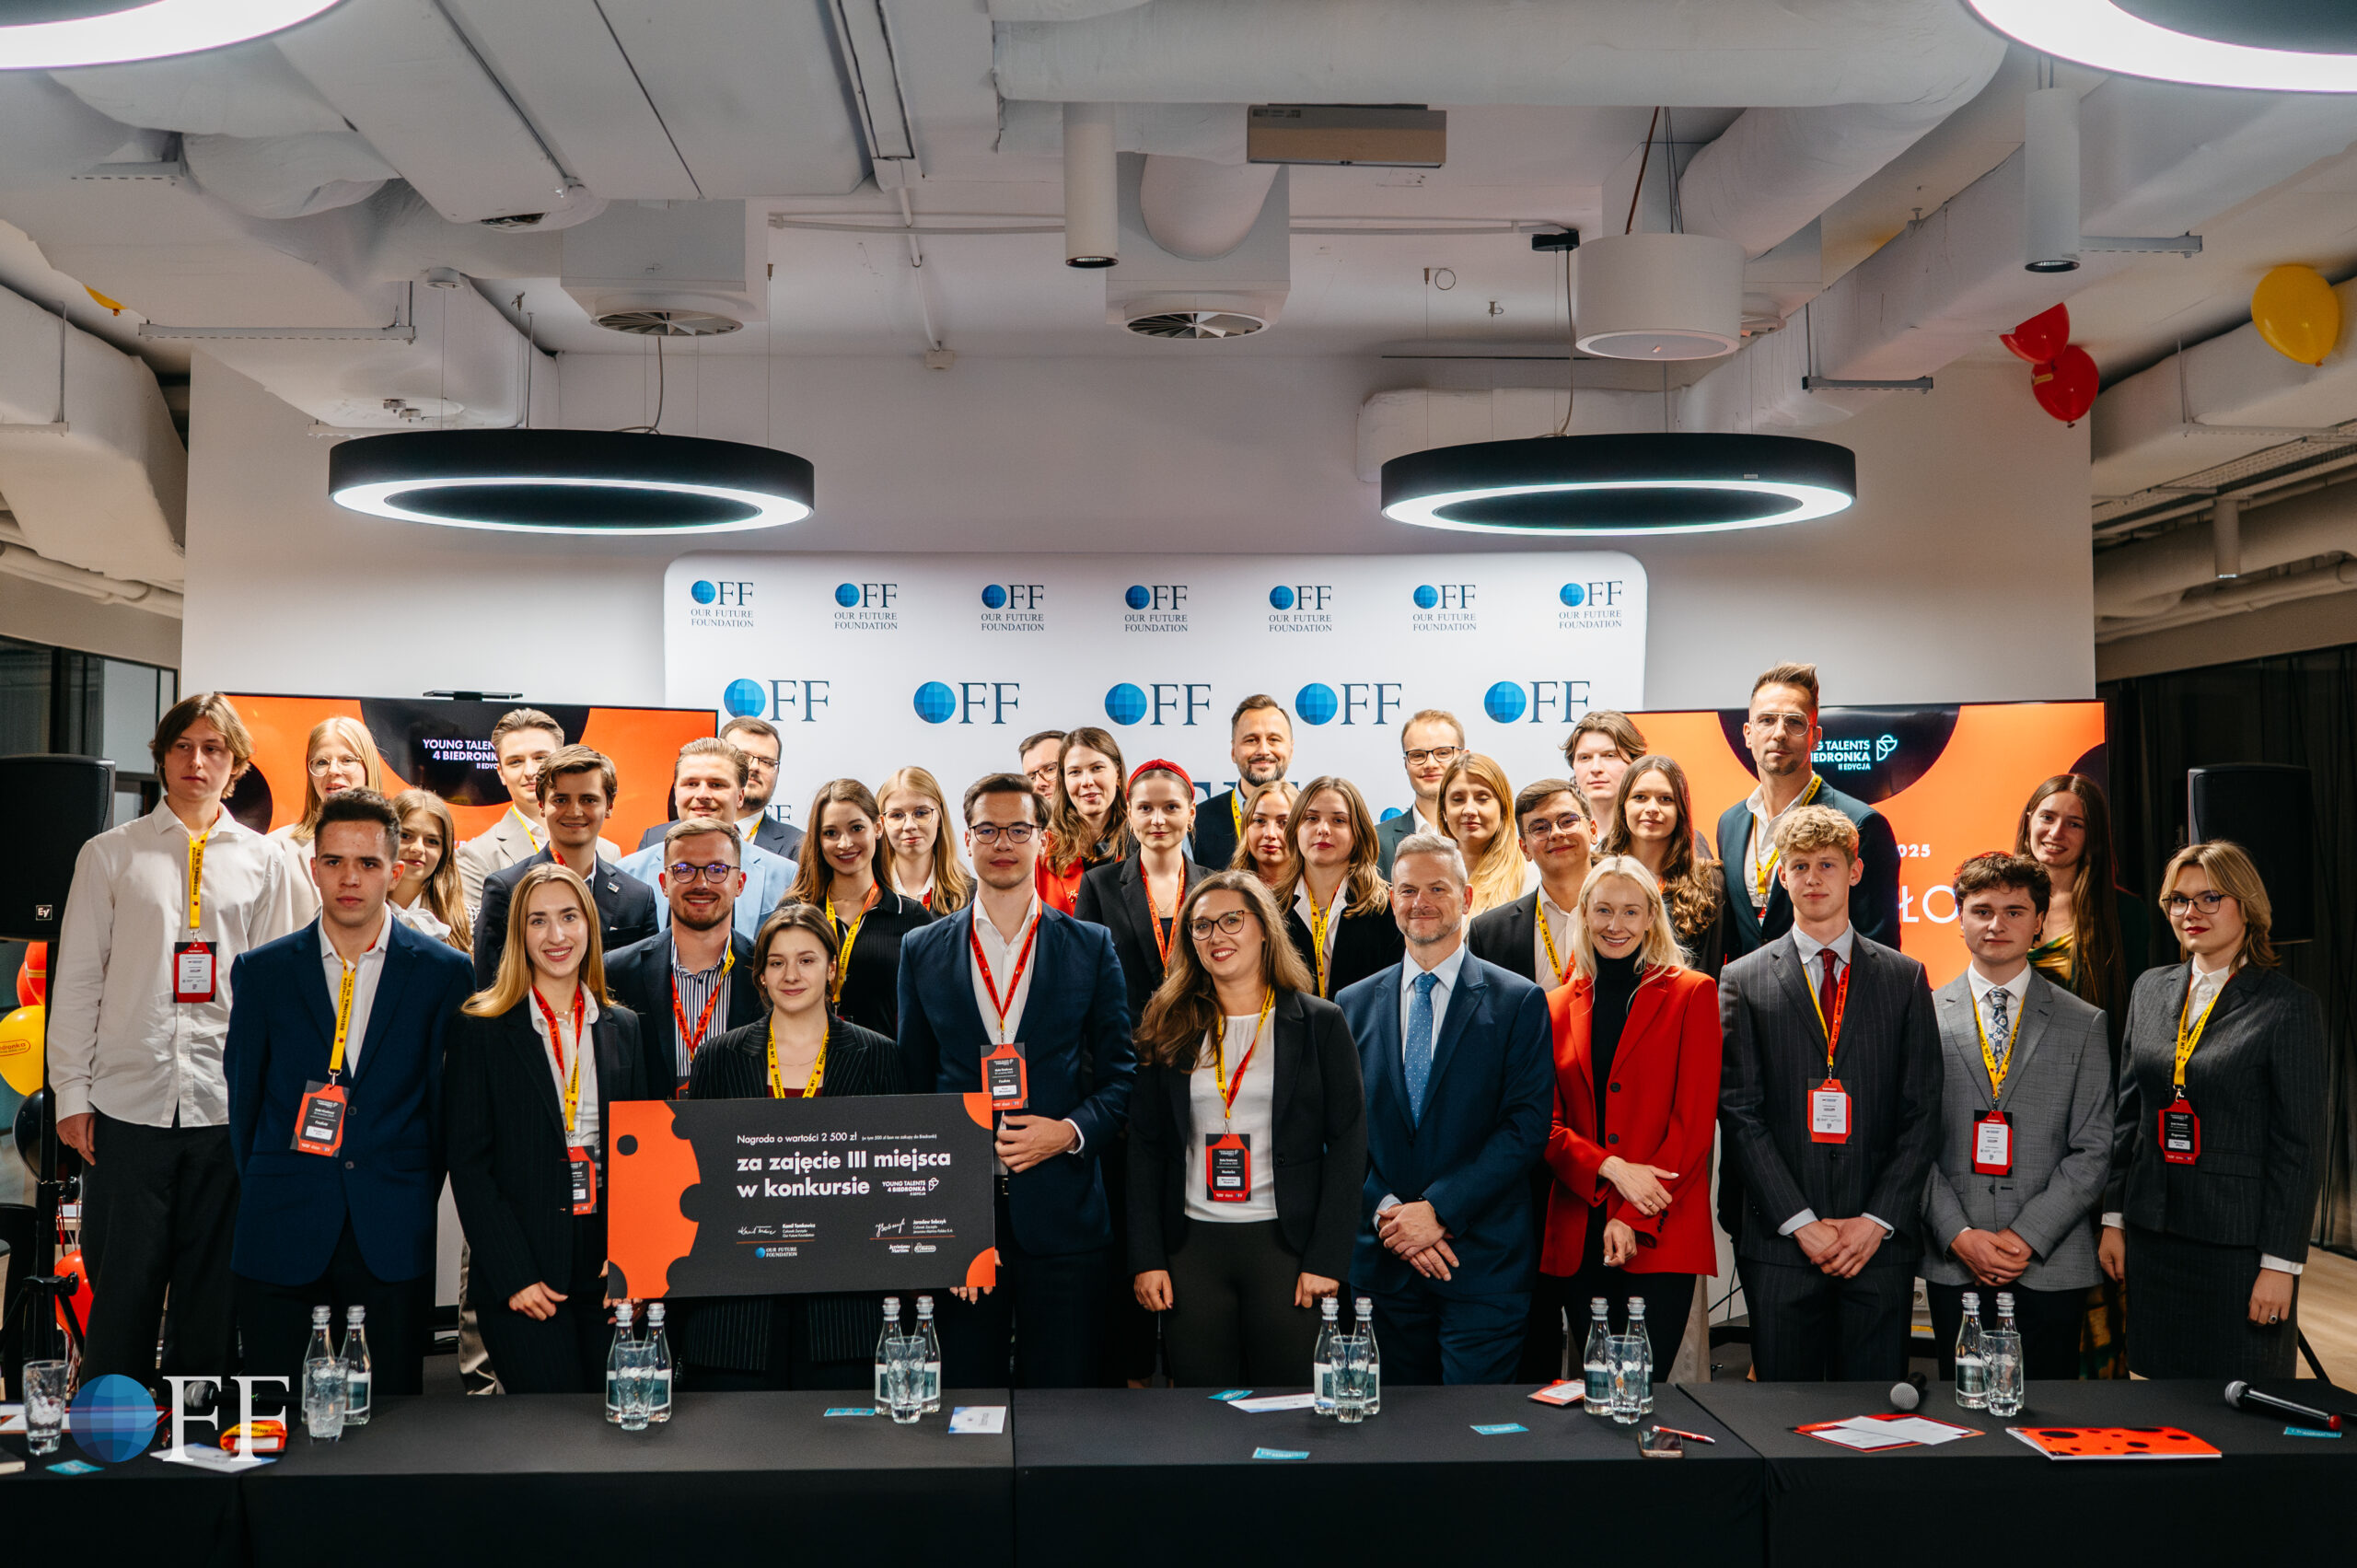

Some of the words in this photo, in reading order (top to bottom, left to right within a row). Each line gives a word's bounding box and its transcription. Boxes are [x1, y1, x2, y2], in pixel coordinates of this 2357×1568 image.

[691, 609, 712, 618] OUR
[715, 609, 754, 618] FUTURE
[834, 611, 855, 621] OUR
[859, 611, 898, 621] FUTURE
[981, 613, 1002, 622] OUR
[1005, 613, 1044, 622] FUTURE
[1124, 613, 1145, 622] OUR
[1149, 613, 1188, 622] FUTURE
[1269, 614, 1290, 623] OUR
[1294, 614, 1332, 623] FUTURE
[1412, 613, 1434, 622] OUR
[1437, 613, 1476, 622] FUTURE
[1559, 610, 1580, 619] OUR
[1584, 610, 1622, 619] FUTURE
[691, 619, 754, 628] FOUNDATION
[834, 621, 898, 631] FOUNDATION
[981, 622, 1044, 632] FOUNDATION
[1124, 623, 1188, 633] FOUNDATION
[1269, 623, 1332, 633] FOUNDATION
[1412, 622, 1476, 632] FOUNDATION
[1559, 620, 1622, 629] FOUNDATION
[423, 738, 464, 750] YOUNG
[465, 740, 496, 750] TALEN
[1825, 739, 1871, 751] TALENTS
[432, 750, 441, 761] 4
[442, 750, 499, 761] BIEDRONK
[1810, 751, 1871, 762] IEDRONKA
[1843, 762, 1871, 771] EDYCJA
[1898, 843, 1931, 857] 025
[774, 1074, 783, 1098] BIEDRON
[737, 1133, 775, 1145] Nagroda
[784, 1132, 819, 1144] wartości
[821, 1132, 828, 1142] 2
[830, 1132, 848, 1142] 500
[849, 1131, 858, 1142] zł
[737, 1157, 762, 1172] za
[769, 1150, 841, 1175] zajęcie
[847, 1150, 867, 1168] III
[874, 1148, 951, 1172] miejsca
[737, 1184, 759, 1198] w
[764, 1175, 870, 1197] konkursie
